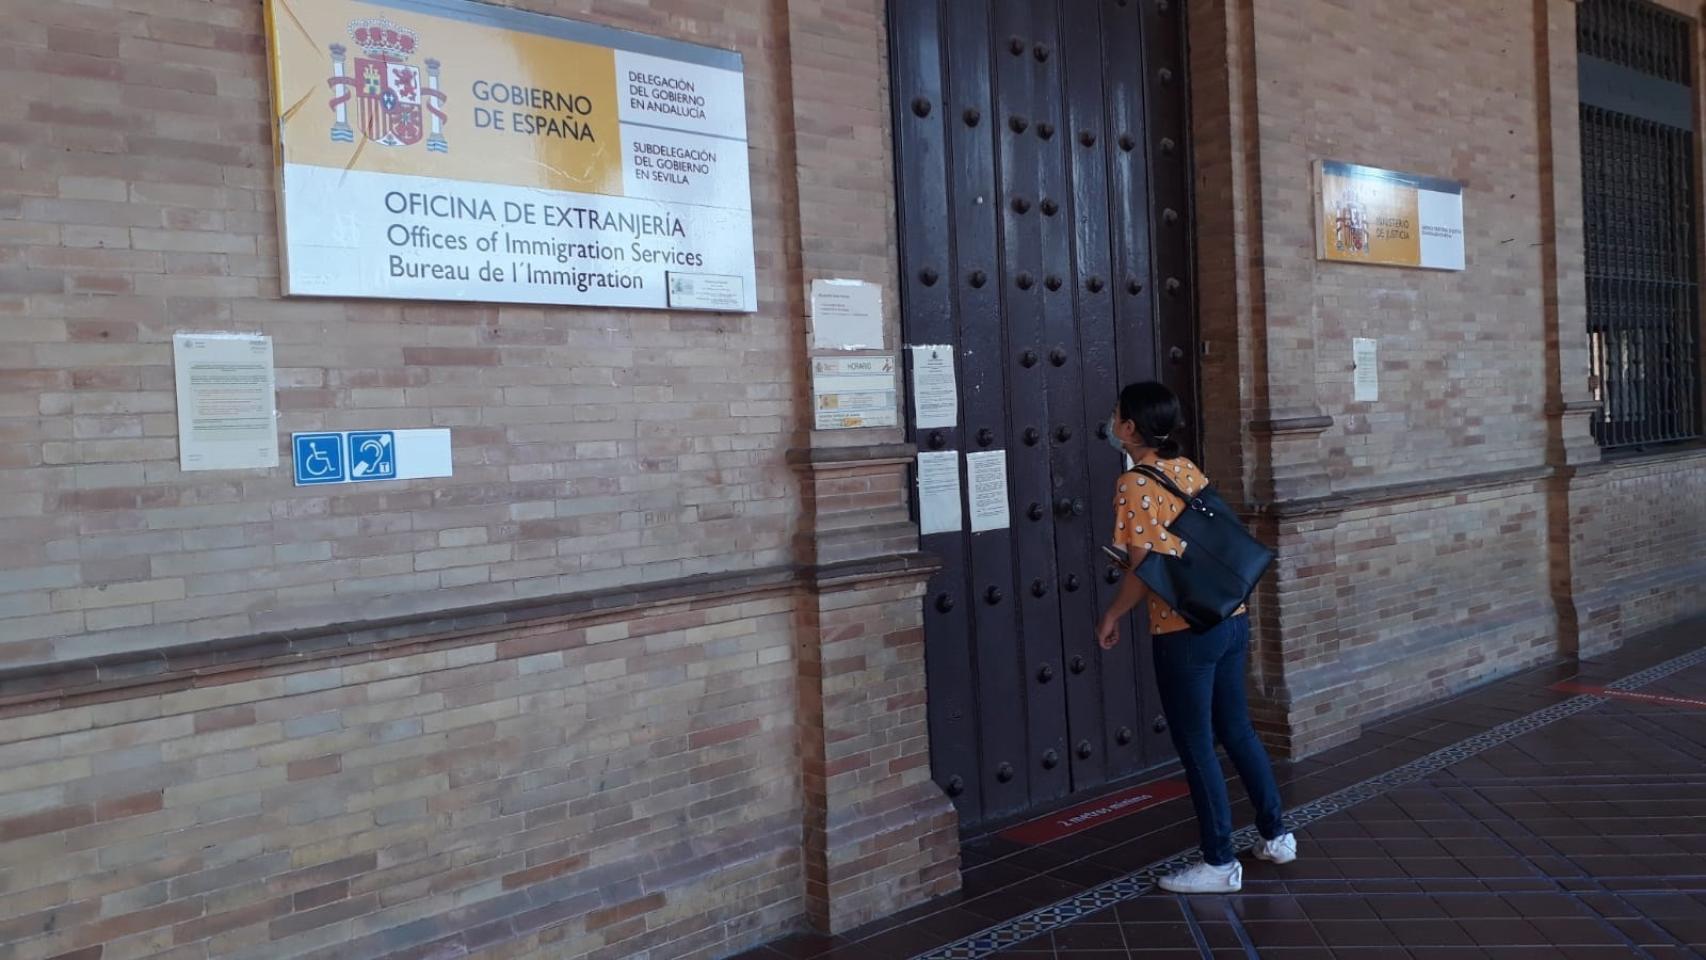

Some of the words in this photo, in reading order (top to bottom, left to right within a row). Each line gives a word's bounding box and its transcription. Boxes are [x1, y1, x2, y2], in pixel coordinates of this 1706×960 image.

[629, 71, 694, 92] DELEGACIÓN
[472, 80, 592, 115] GOBIERNO
[630, 85, 648, 97] DEL
[652, 88, 705, 107] GOBIERNO
[630, 98, 645, 110] EN
[647, 101, 706, 120] ANDALUCÍA
[474, 107, 505, 130] DE
[513, 112, 595, 142] ESPAÑA
[633, 142, 717, 162] SUBDELEGACIÓN
[634, 156, 653, 167] DEL
[657, 159, 709, 175] GOBIERNO
[635, 169, 650, 180] EN
[652, 171, 690, 185] SEVILLA
[385, 191, 496, 221] OFICINA
[504, 201, 536, 224] DE
[544, 205, 686, 239] EXTRANJERÍA
[1376, 217, 1409, 229] MINISTERIO
[1376, 227, 1385, 238] DE
[1386, 229, 1409, 240] JUSTICIA
[387, 223, 468, 250] Offices
[476, 231, 499, 252] of
[506, 232, 625, 263] Immigration
[631, 242, 703, 267] Services
[389, 255, 470, 280] Bureau
[478, 260, 504, 282] de
[847, 362, 872, 370] HORARIO
[1069, 807, 1112, 824] metros
